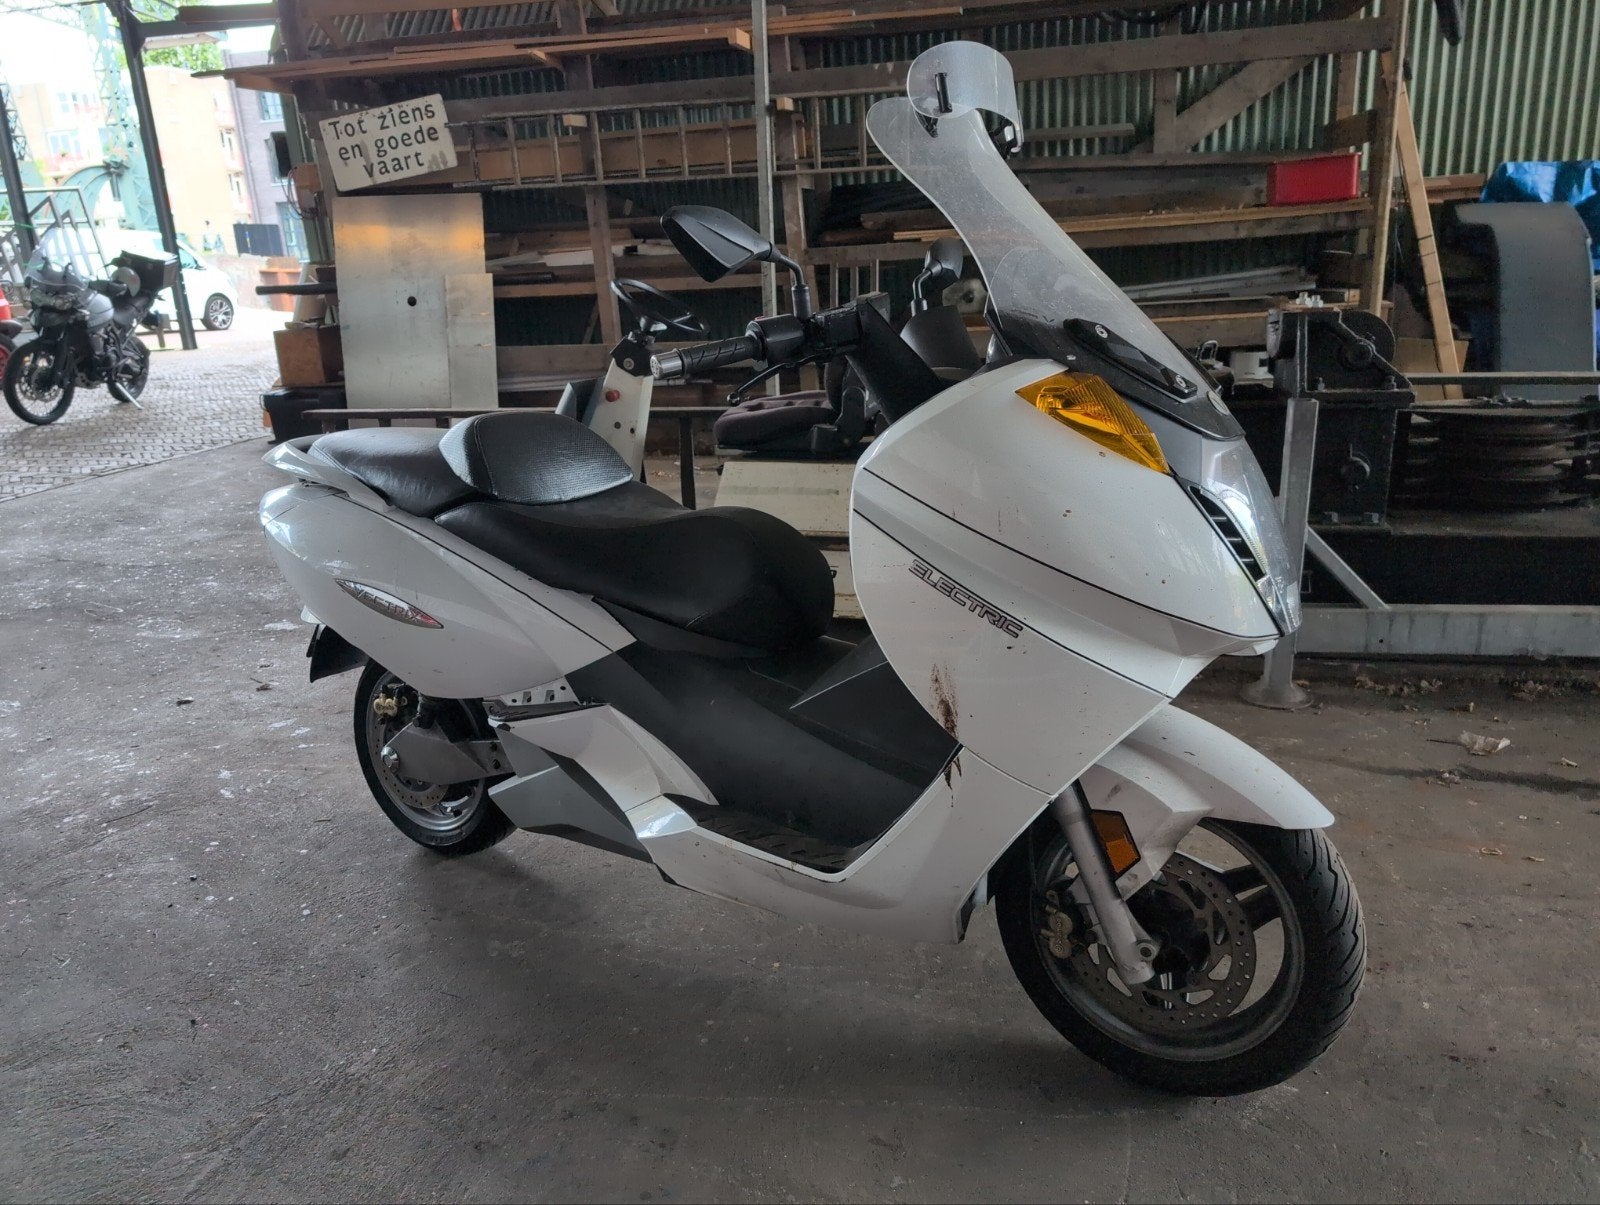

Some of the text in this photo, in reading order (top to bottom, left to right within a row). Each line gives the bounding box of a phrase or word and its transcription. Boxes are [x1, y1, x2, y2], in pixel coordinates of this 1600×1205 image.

[328, 103, 436, 140] Tot ziens
[338, 124, 440, 161] en goede
[363, 151, 425, 178] vaart
[908, 558, 1024, 639] ELECTRIC
